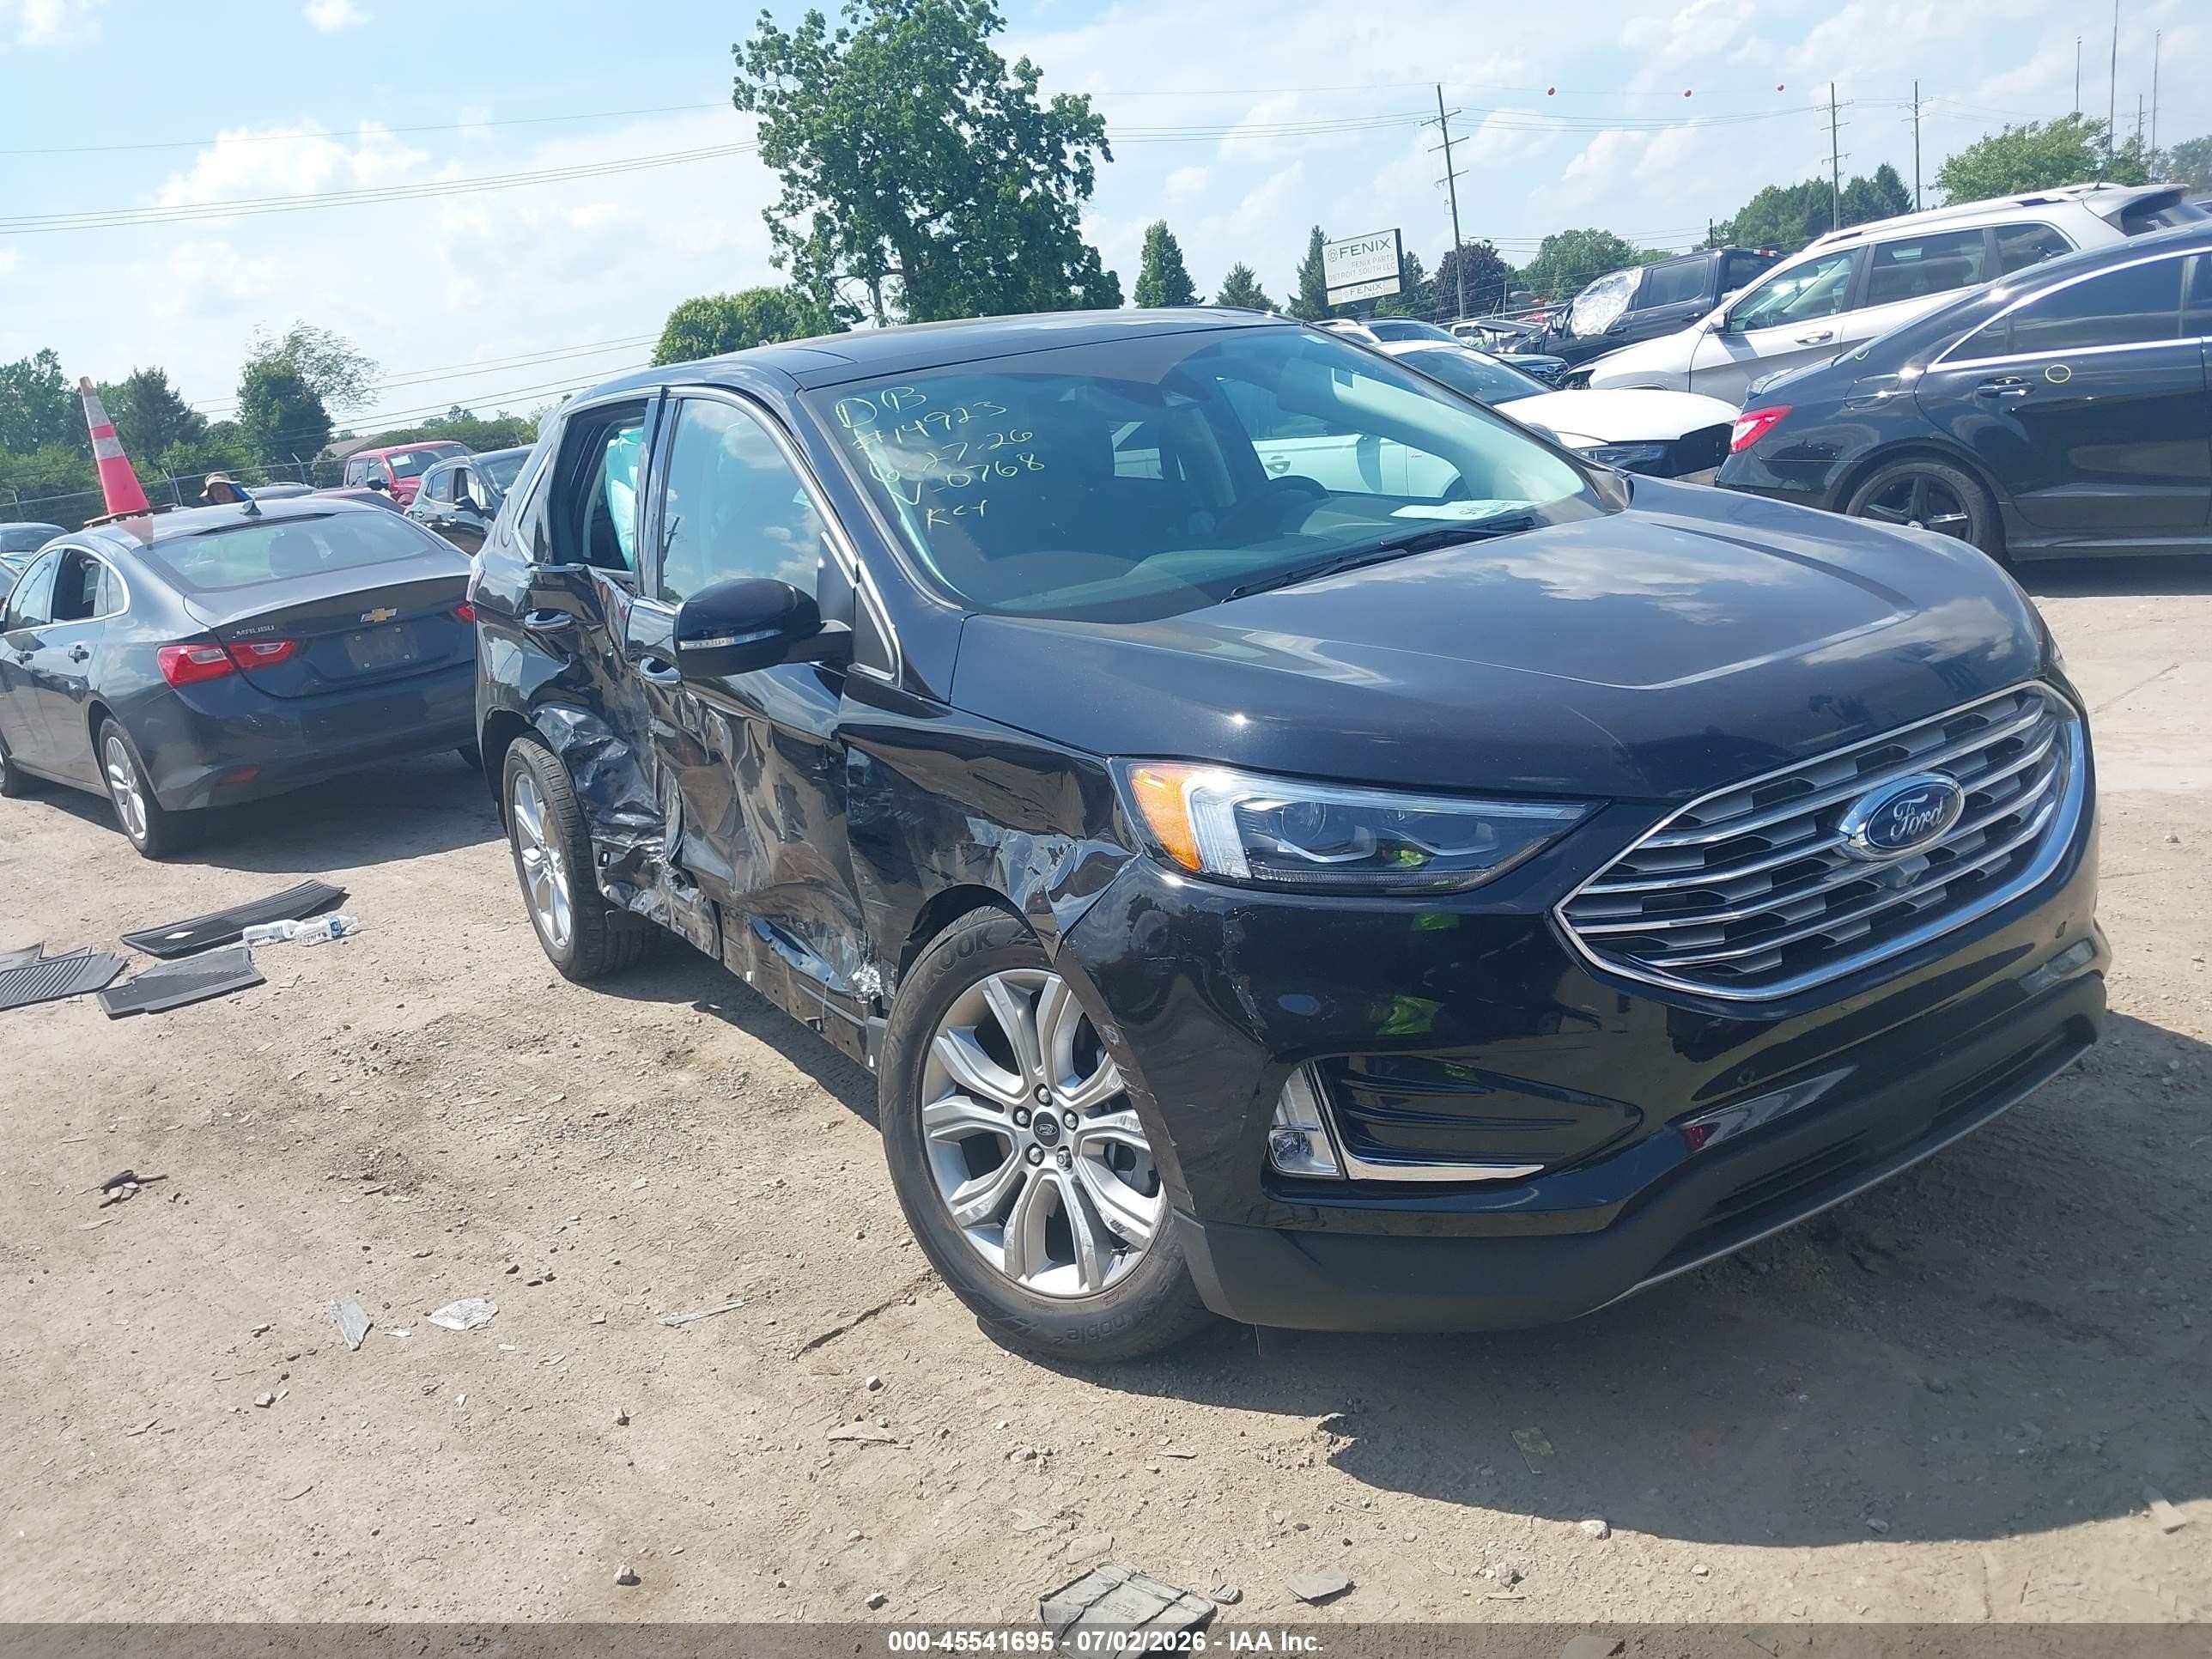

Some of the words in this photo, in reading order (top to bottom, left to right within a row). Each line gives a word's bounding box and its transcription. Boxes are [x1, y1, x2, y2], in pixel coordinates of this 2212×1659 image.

[1340, 238, 1391, 258] FENIX
[1372, 254, 1395, 264] PARTS
[1328, 270, 1356, 282] DETROIT
[1358, 266, 1381, 275] SOUTH
[1382, 262, 1395, 270] LLC
[1351, 283, 1382, 295] FENIX
[853, 401, 1007, 452] #14923
[236, 625, 275, 636] MALIBU
[1891, 793, 1944, 842] Ford
